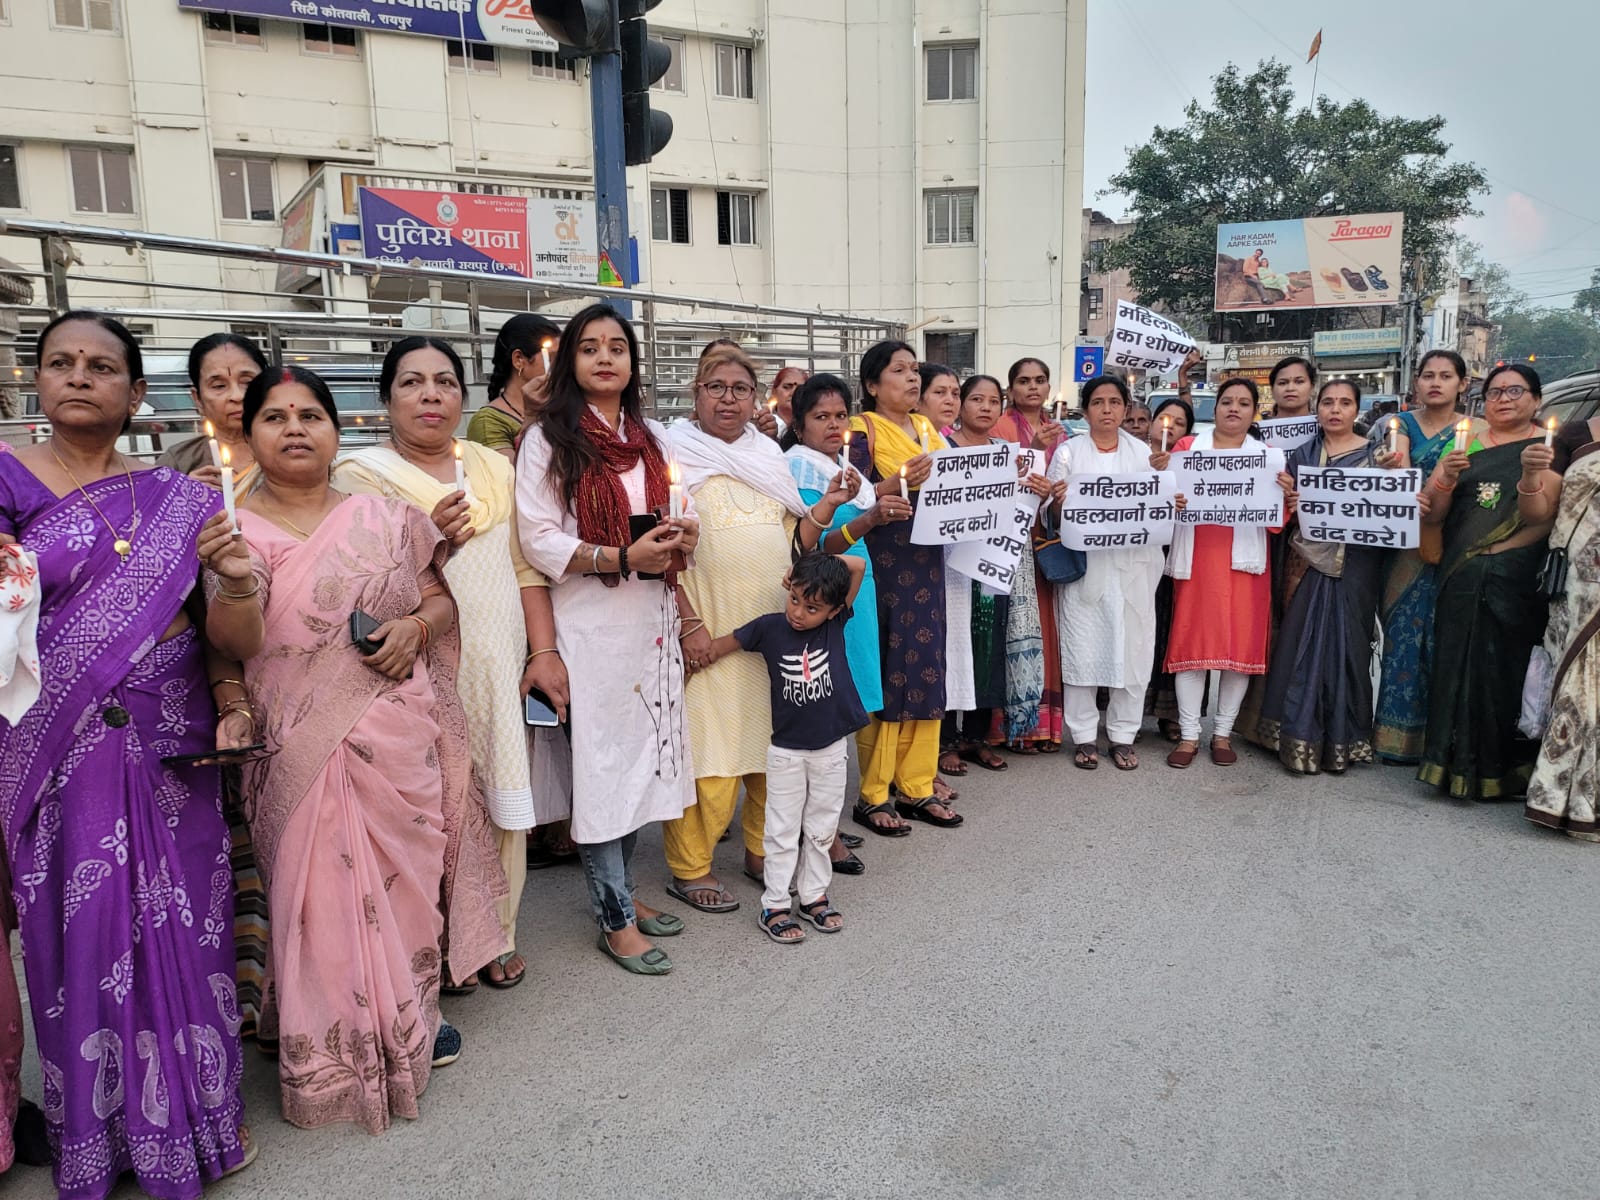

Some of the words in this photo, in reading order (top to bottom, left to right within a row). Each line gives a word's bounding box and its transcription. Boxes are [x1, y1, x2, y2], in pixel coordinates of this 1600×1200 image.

[291, 1, 318, 15] सिटी
[322, 6, 375, 24] कोतवाली,
[378, 13, 412, 31] रायपुर
[501, 25, 524, 34] Finest
[376, 218, 453, 254] पुलिस
[462, 228, 520, 249] थाना
[1329, 220, 1392, 240] Paragon
[1116, 328, 1143, 345] का
[1086, 363, 1092, 373] P
[1115, 349, 1142, 367] बंद
[937, 453, 990, 479] ब्रजभूषण
[992, 445, 1010, 467] की
[1183, 451, 1216, 471] महिला
[1219, 450, 1267, 470] पहलवानों
[1080, 475, 1160, 499] महिलाओं
[1193, 478, 1204, 497] के
[1207, 482, 1243, 497] सम्मान
[1244, 477, 1255, 497] में
[1299, 468, 1418, 492] महिलाओं
[924, 482, 963, 507] सांसद
[964, 481, 1015, 502] सदस्यता
[1063, 502, 1146, 524] पहलवानों
[1149, 500, 1174, 521] को
[1203, 504, 1236, 525] कांग्रेस
[1238, 504, 1267, 523] मैदान
[1268, 503, 1279, 522] में
[1299, 500, 1336, 516] का
[1341, 497, 1417, 520] शोषण
[1083, 533, 1127, 547] न्याय
[1130, 528, 1150, 545] दो
[1308, 521, 1348, 541] बंद
[978, 558, 1017, 585] करो
[781, 666, 833, 707] महाकाल
